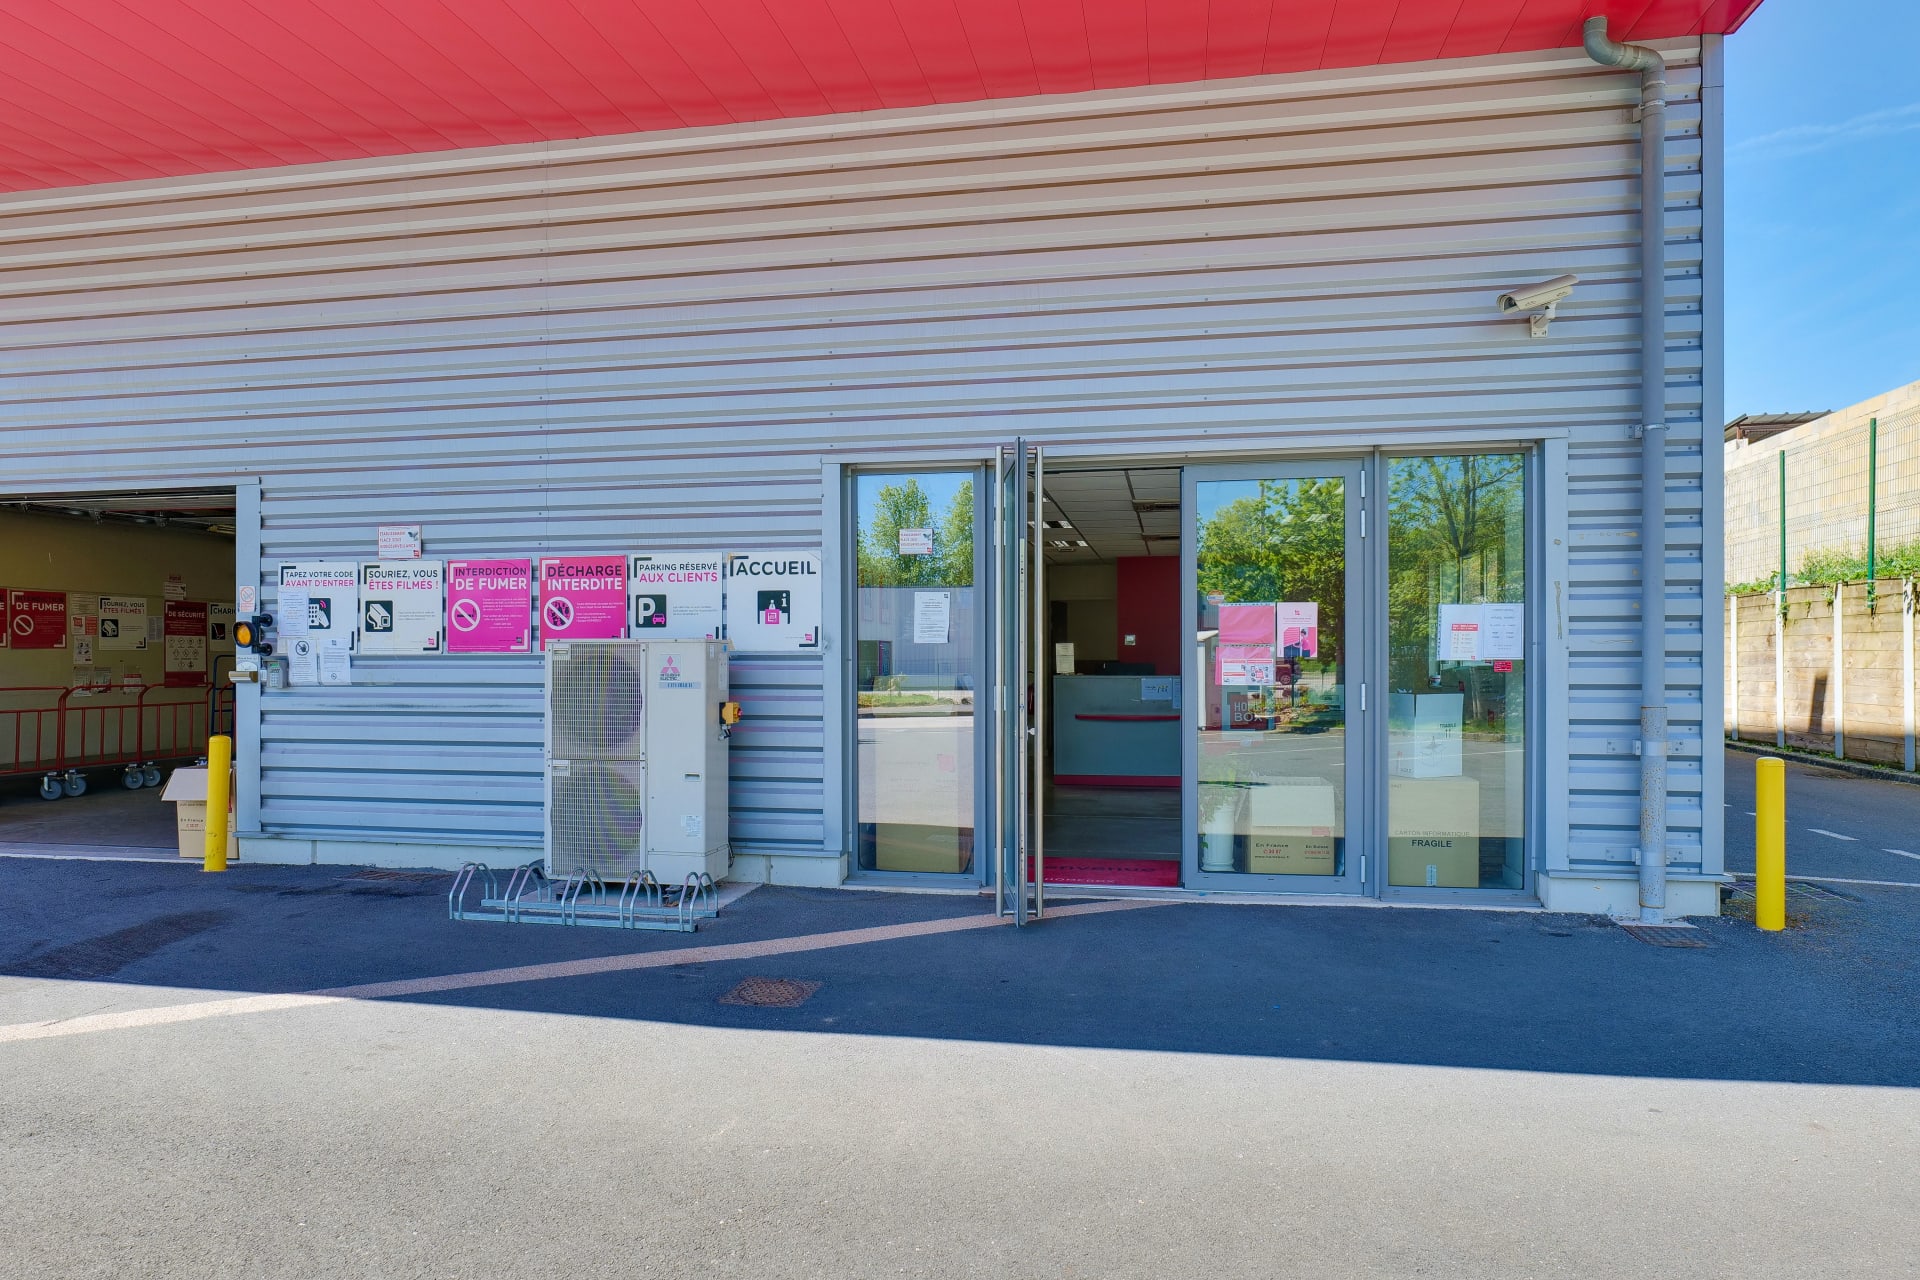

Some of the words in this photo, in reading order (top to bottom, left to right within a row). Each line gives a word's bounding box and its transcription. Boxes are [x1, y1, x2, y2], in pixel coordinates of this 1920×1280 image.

[548, 563, 622, 577] DÉCHARGE
[640, 563, 677, 571] PARKING
[680, 561, 718, 571] RÉSERVÉ
[736, 561, 817, 576] ACCUEIL
[334, 570, 353, 578] CODE
[368, 570, 410, 579] SOURIEZ,
[413, 569, 438, 578] VOUS
[455, 567, 527, 576] INTERDICTION
[639, 573, 664, 583] AUX
[668, 572, 718, 582] CLIENTS
[315, 579, 354, 587] D'ENTRER
[368, 580, 393, 590] ÊTES
[396, 578, 433, 590] FILMÉS
[455, 578, 474, 591] DE
[479, 577, 527, 590] FUMER
[547, 578, 623, 591] INTERDITE
[16, 602, 29, 610] DE
[32, 603, 65, 611] FUMER
[1411, 839, 1453, 848] FRAGILE
